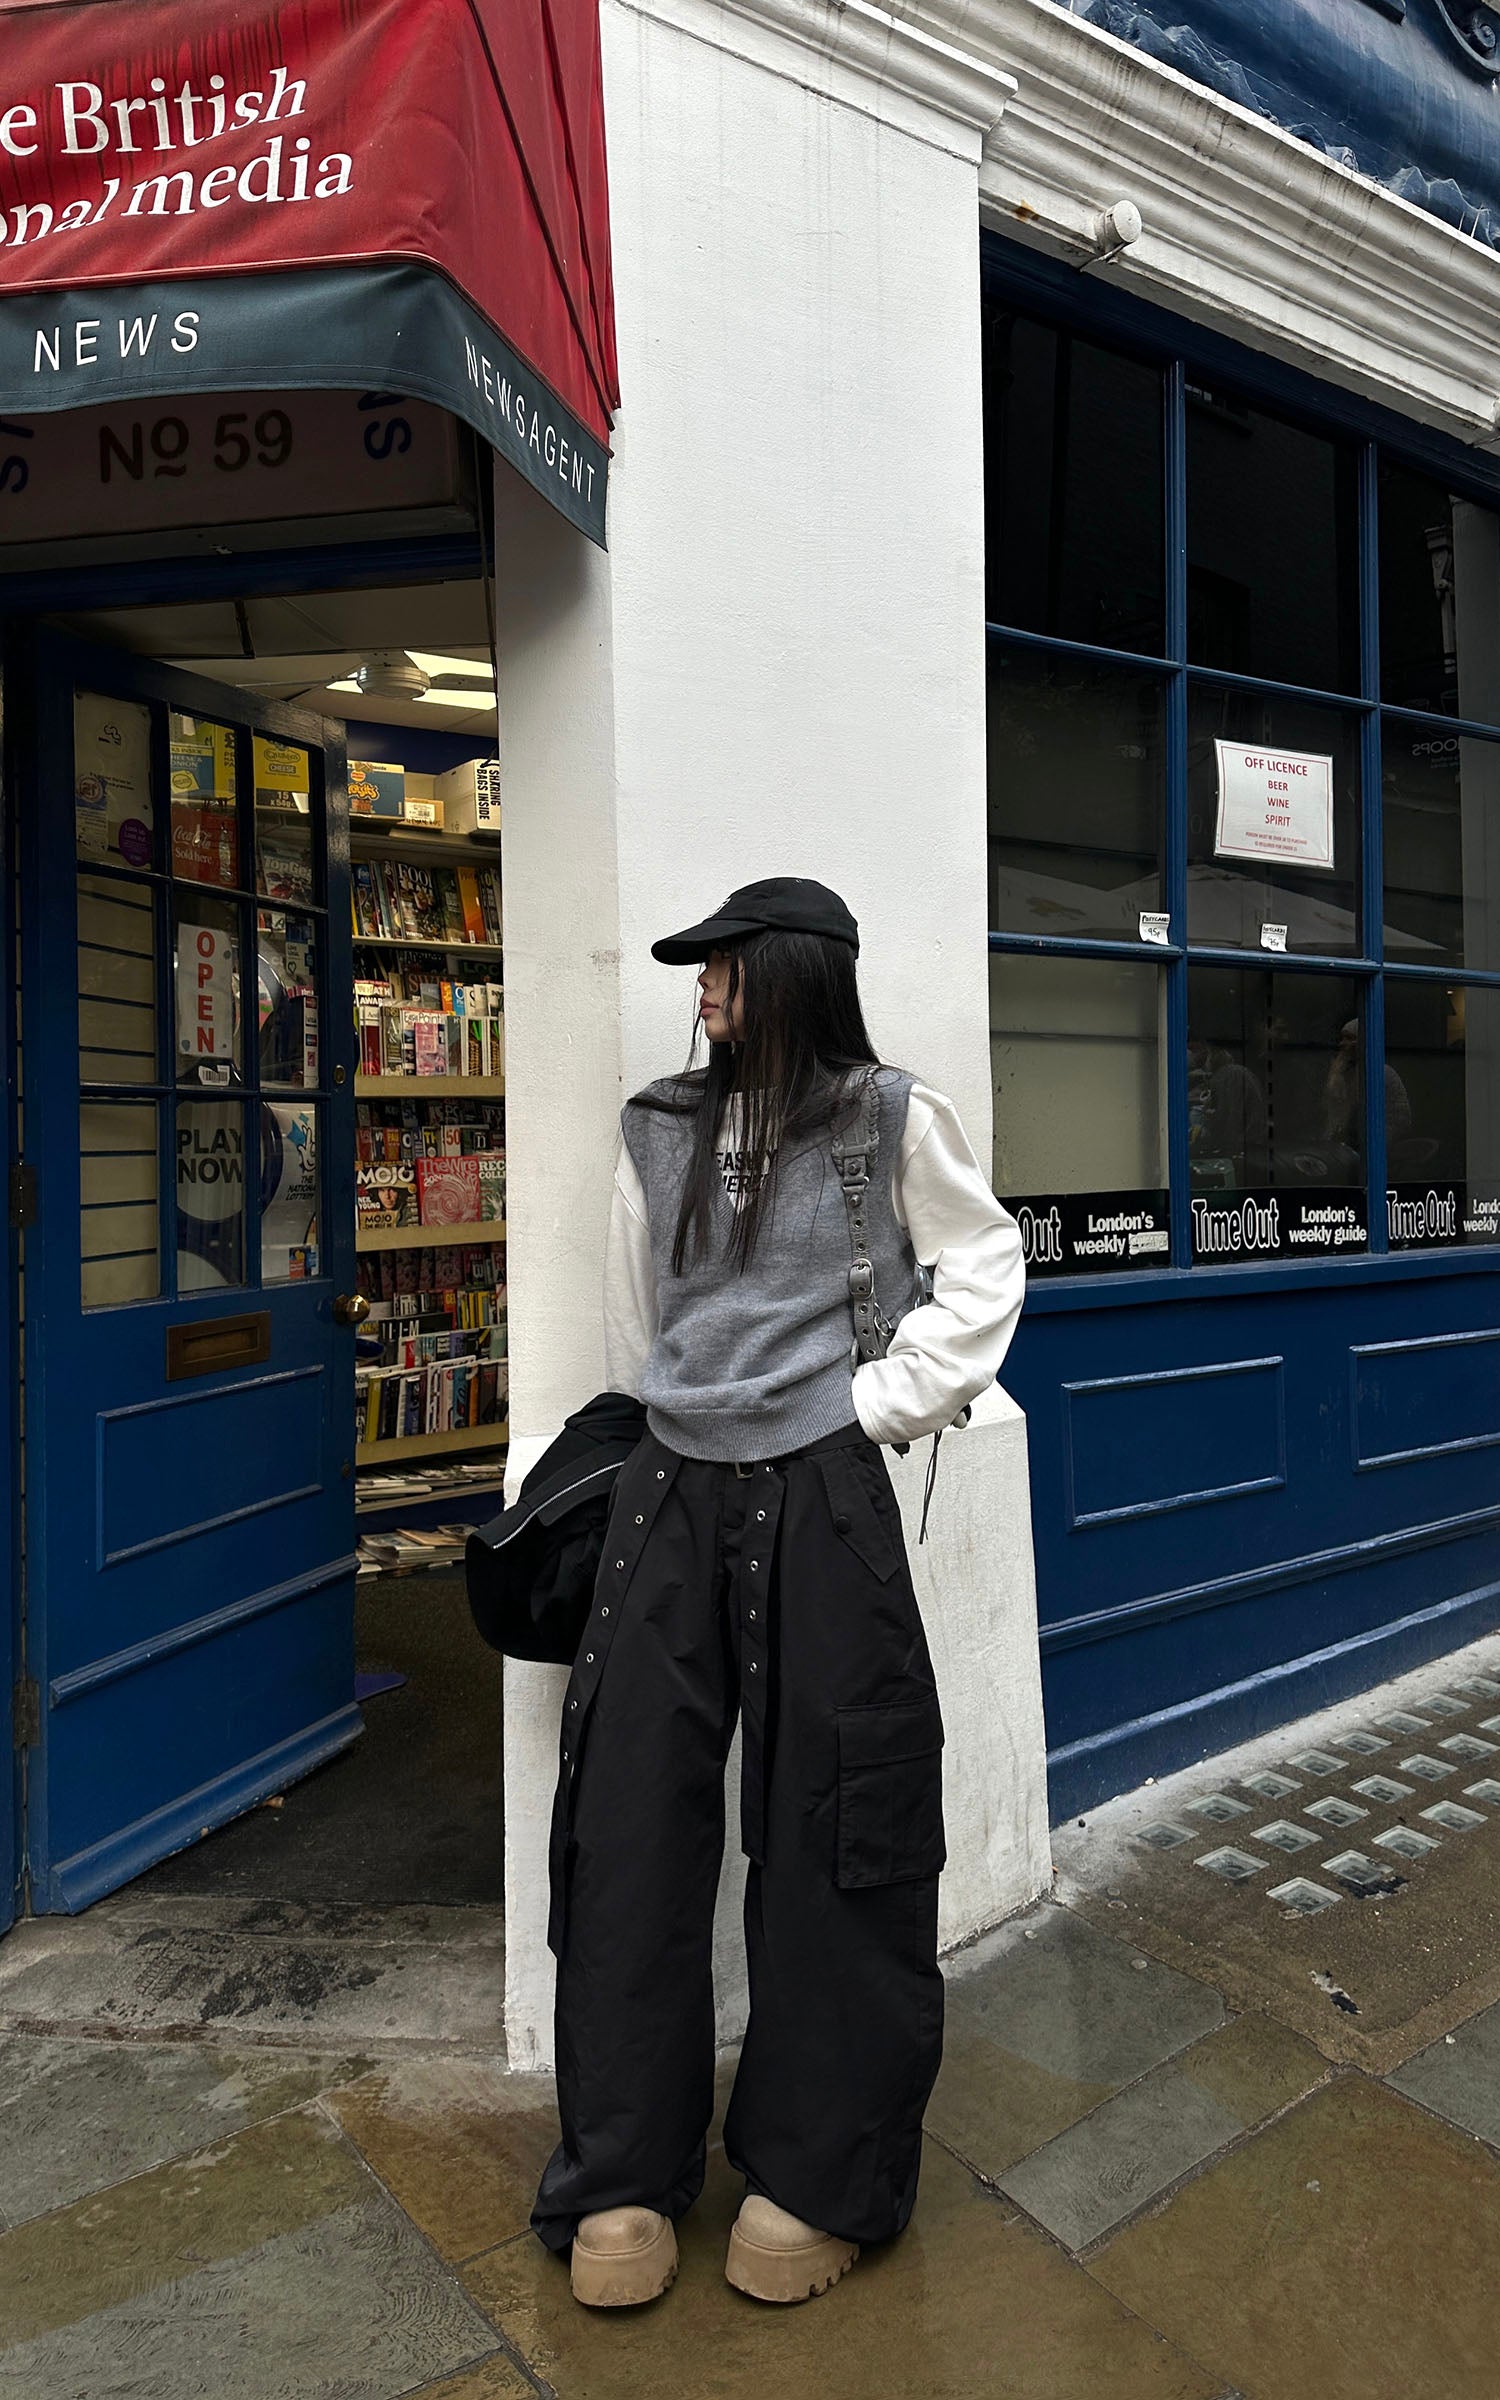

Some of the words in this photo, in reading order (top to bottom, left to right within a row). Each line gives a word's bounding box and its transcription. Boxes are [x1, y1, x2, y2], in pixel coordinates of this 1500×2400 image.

[55, 66, 306, 155] British
[0, 178, 120, 247] nal
[121, 137, 353, 217] media
[34, 312, 200, 373] NEWS
[464, 336, 596, 503] NEWSAGENT
[214, 409, 293, 471] 59
[1244, 756, 1264, 769] OFF
[1267, 760, 1308, 776] LICENCE
[477, 769, 489, 791] BAGS
[489, 769, 501, 806] SHARING
[1268, 780, 1288, 791] BEER
[277, 792, 289, 800] 15
[478, 793, 490, 820] INSIDE
[1267, 797, 1290, 808] WINE
[1265, 814, 1291, 827] SPIRIT
[196, 931, 216, 1053] OPEN
[301, 1175, 314, 1184] THE
[356, 1166, 415, 1185] MOJO
[359, 1202, 381, 1210] YOUNG
[1301, 1206, 1356, 1223] London's
[1385, 1190, 1425, 1240] Time
[1425, 1190, 1457, 1238] Out
[1088, 1211, 1155, 1233] London's
[1191, 1198, 1242, 1253] Time
[1242, 1197, 1281, 1250] Out
[1463, 1216, 1498, 1234] weekly
[1017, 1205, 1063, 1264] Out
[1072, 1233, 1127, 1256] weekly
[1289, 1225, 1332, 1246] weekly
[1333, 1225, 1368, 1246] guide
